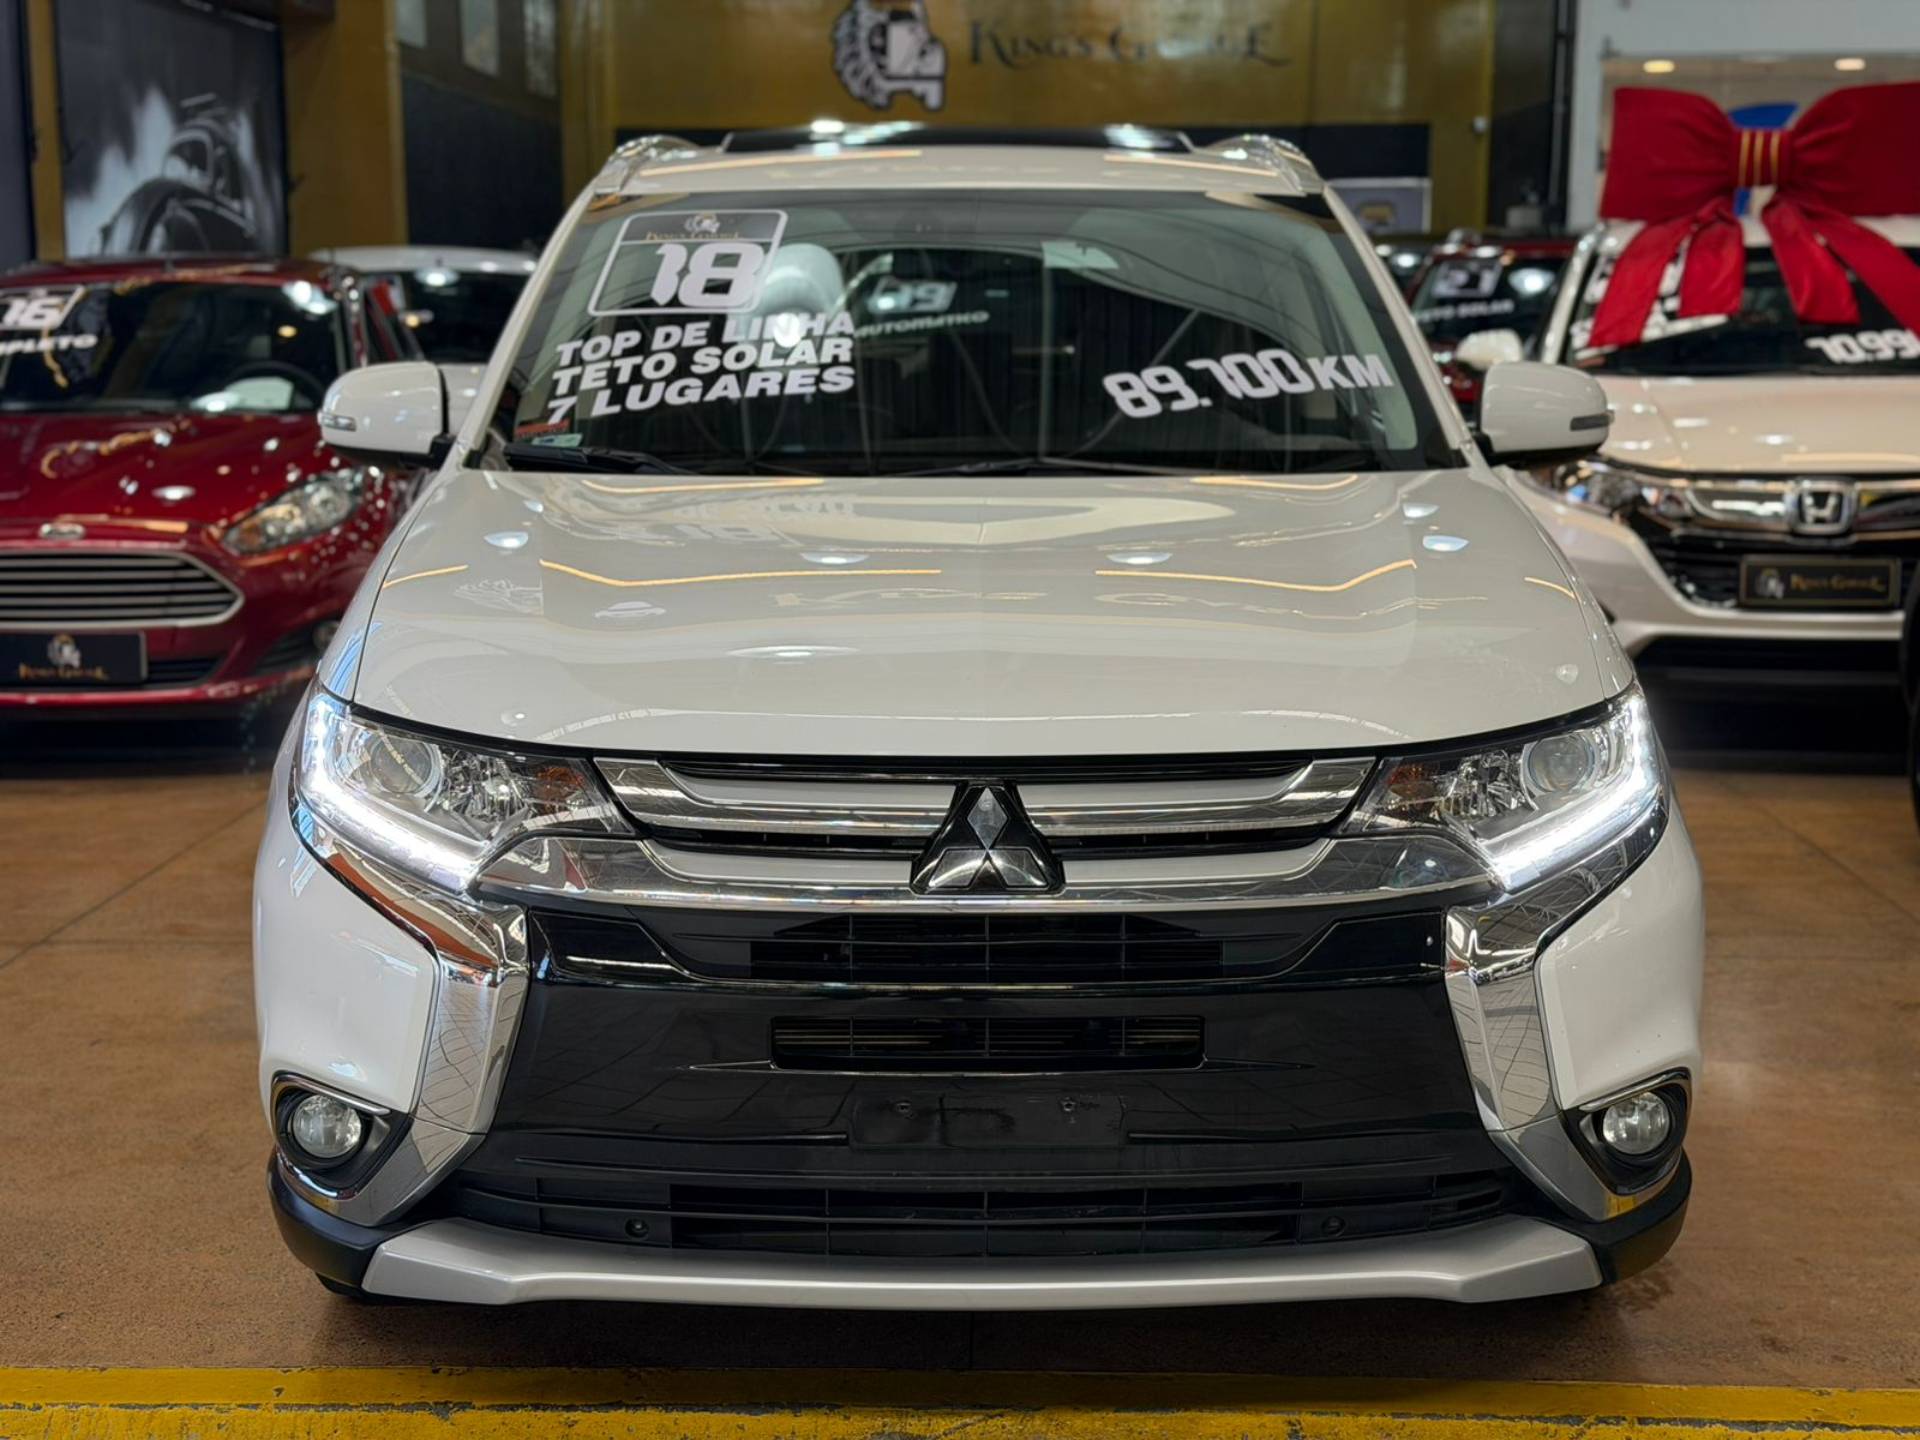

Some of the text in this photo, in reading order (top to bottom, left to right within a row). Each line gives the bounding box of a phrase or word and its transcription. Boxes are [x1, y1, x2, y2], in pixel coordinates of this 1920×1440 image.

[650, 243, 764, 307] 18
[552, 337, 855, 396] TETO SOLAR
[555, 311, 855, 367] TOP DE LINHA
[547, 366, 856, 425] 7 LUGARES
